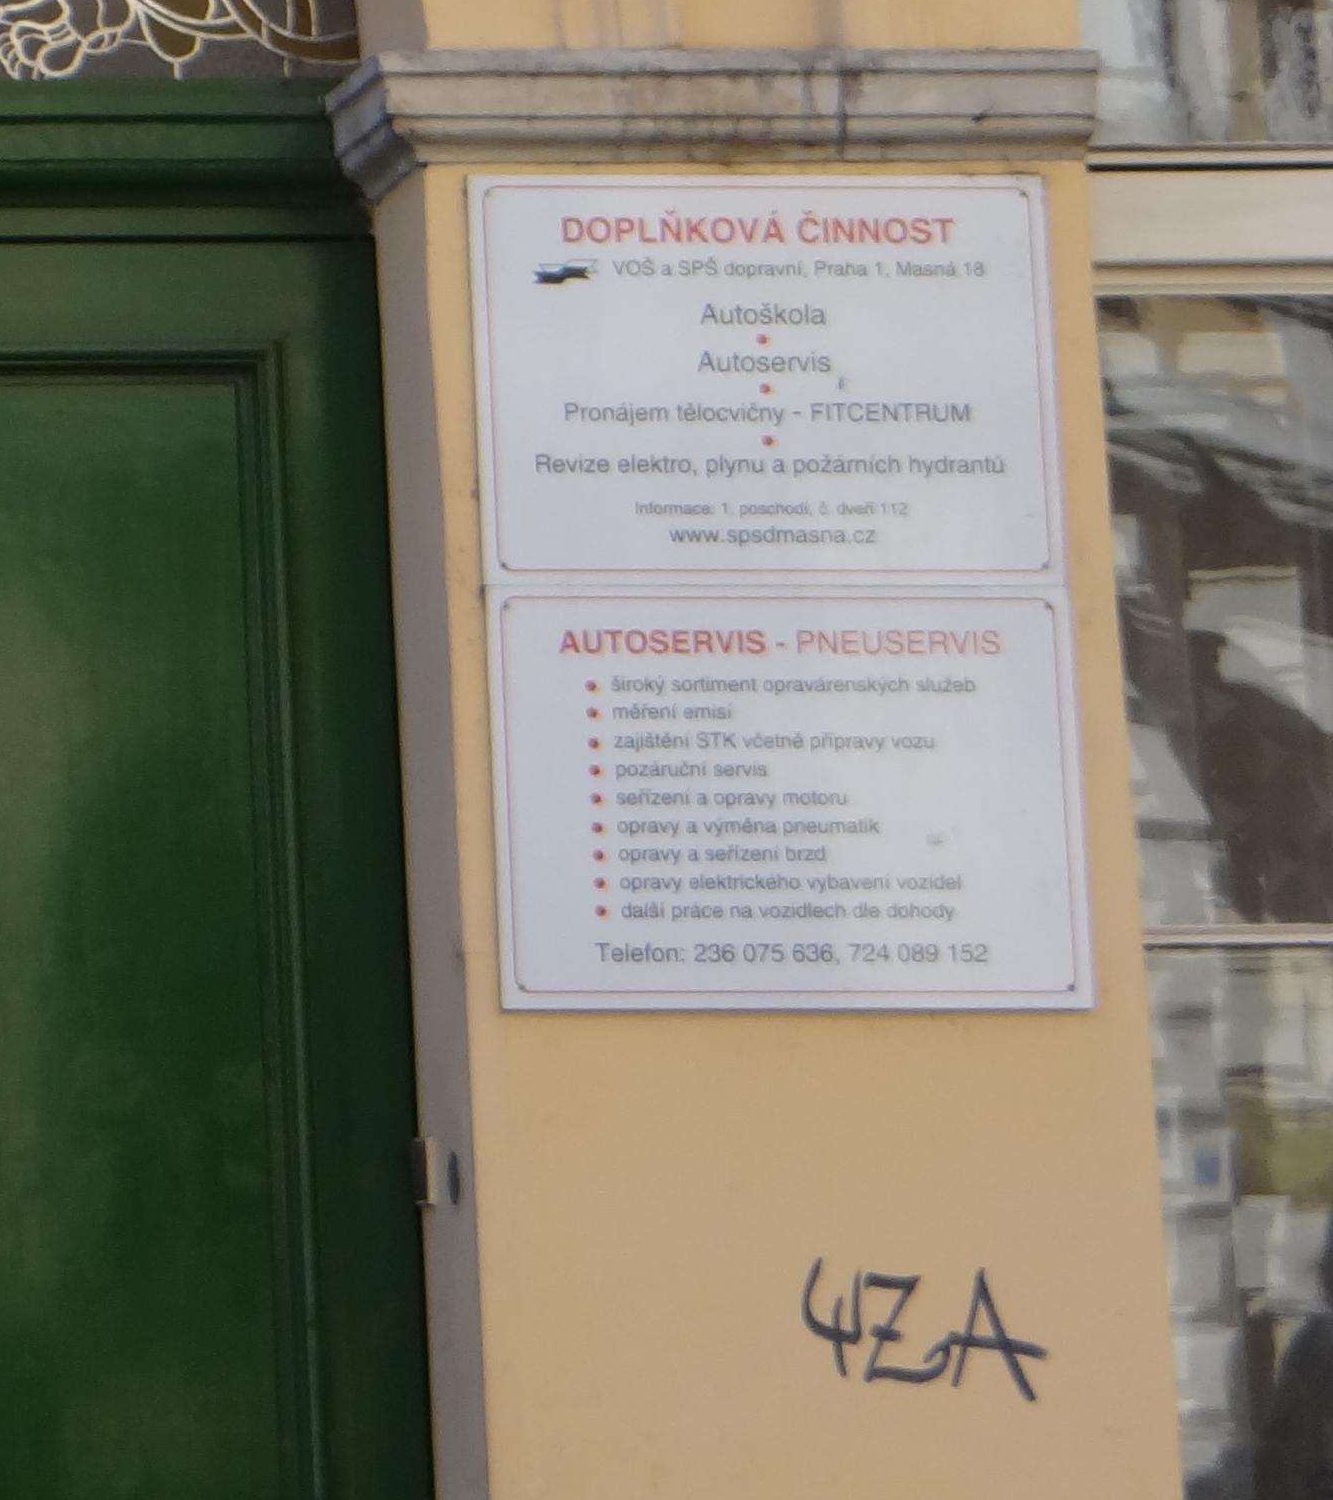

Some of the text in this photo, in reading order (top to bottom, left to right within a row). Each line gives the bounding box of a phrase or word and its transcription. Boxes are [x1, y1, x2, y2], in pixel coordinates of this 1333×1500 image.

[562, 209, 955, 244] DOPLŇKOVÁ ČINNOST
[613, 256, 656, 276] VOŠ
[661, 263, 673, 276] a
[678, 256, 719, 276] SPŠ
[724, 260, 809, 280] dopravní,
[814, 260, 868, 277] Praha
[896, 261, 958, 277] Masná
[964, 261, 986, 277] 18
[701, 302, 826, 325] Autoškola
[698, 350, 832, 373] Autoservis
[564, 402, 670, 426] Pronájem
[676, 402, 785, 426] tělocvičny
[811, 402, 972, 422] FITCENTRUM
[535, 453, 1006, 478] Revize elektro, plynu a požárních hydrantů
[635, 501, 715, 516] Informace:
[669, 525, 876, 547] www.spsdmasna.cz
[559, 629, 767, 655] AUTOSERVIS
[797, 629, 1001, 655] PNEUSERVIS
[611, 675, 976, 696] široký sortiment opravárenských služeb
[612, 702, 732, 719] měření emisí
[614, 731, 936, 753] zajištění STK včetně přípravy vozu
[615, 760, 768, 780] pozáruční servis
[616, 787, 848, 809] seřízení a opravy motoru
[617, 817, 880, 837] opravy a výměna pneumatik
[618, 844, 827, 865] opravy a seřízení brzd
[620, 873, 963, 894] opravy elektrického vybavení vozidel
[621, 902, 955, 922] další práce na vozidlech dle dohody
[594, 942, 989, 966] Telefon: 236 075 636, 724 089 152
